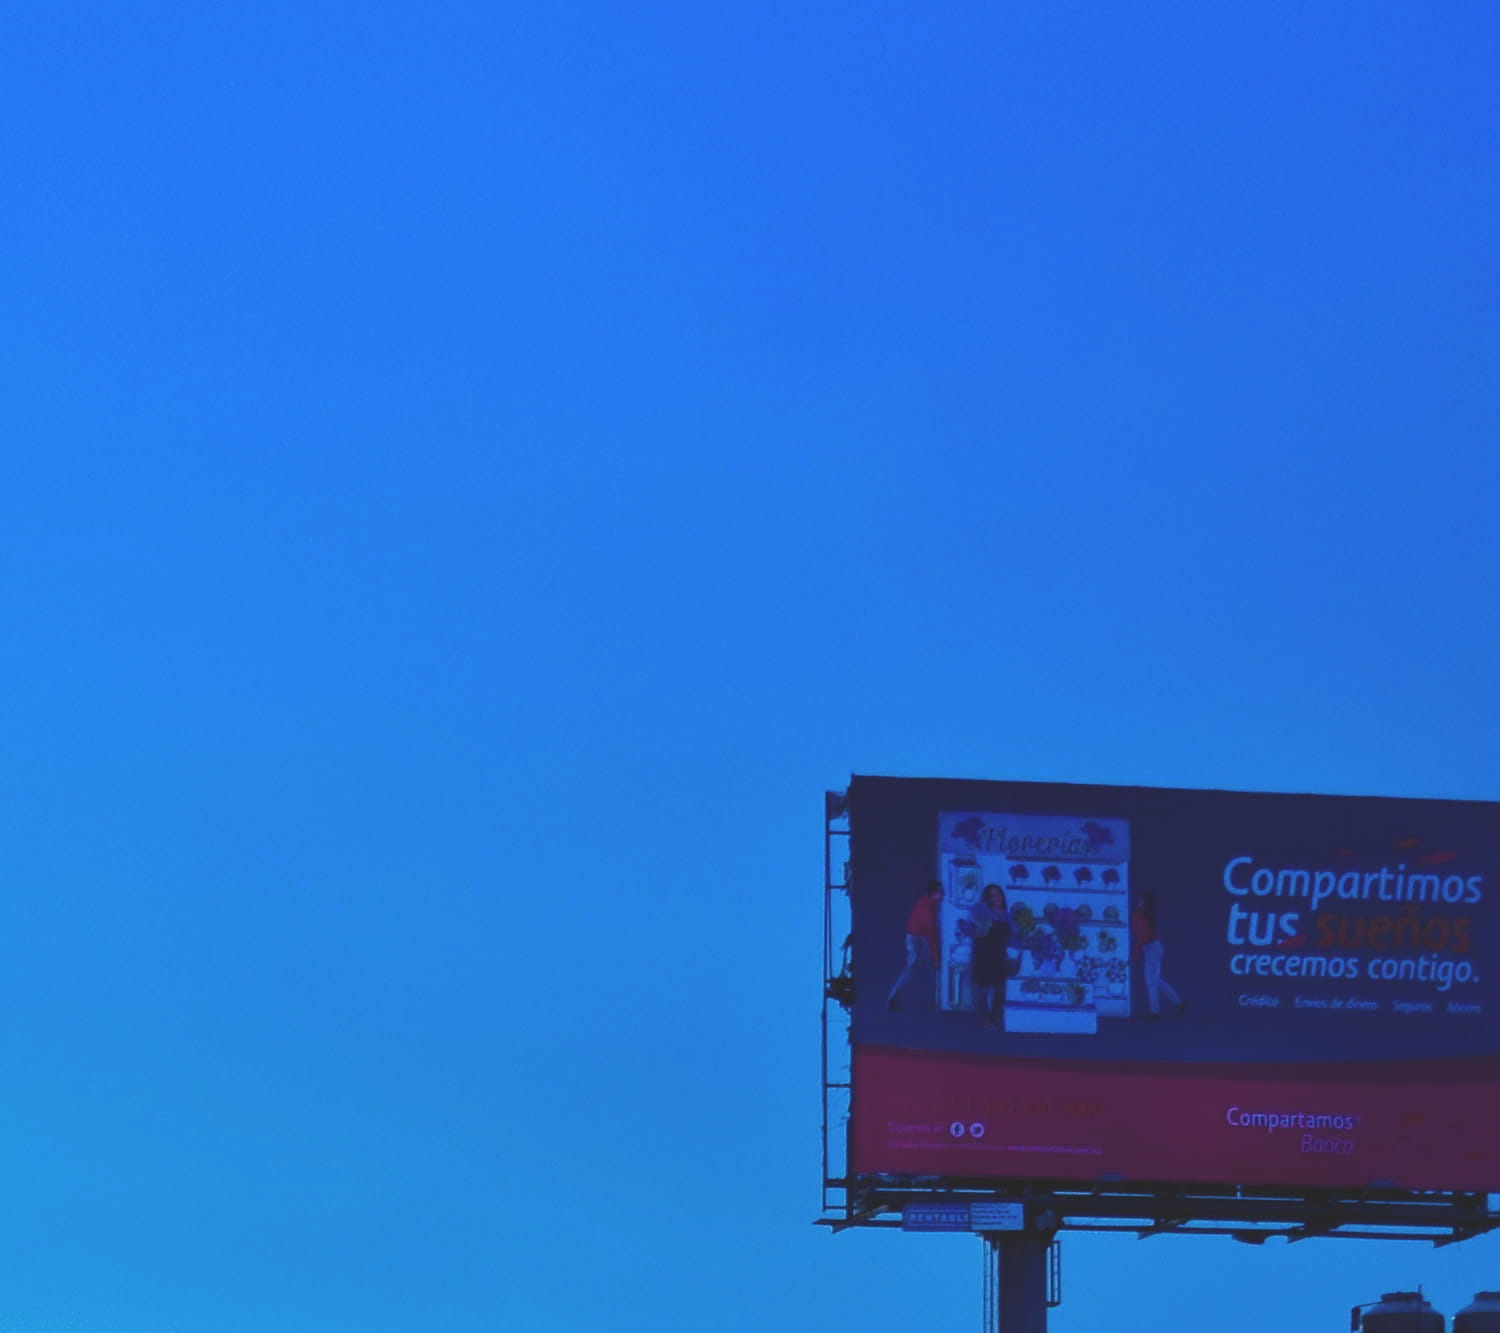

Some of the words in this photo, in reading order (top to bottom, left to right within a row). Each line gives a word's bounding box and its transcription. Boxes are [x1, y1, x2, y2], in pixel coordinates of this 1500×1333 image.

[1223, 856, 1482, 911] Compartimos
[1227, 903, 1299, 946] tus
[1315, 904, 1473, 951] sueños
[1230, 953, 1358, 979] crecemos
[1367, 953, 1480, 991] contigo.
[1226, 1106, 1353, 1135] Compartamos
[1301, 1133, 1355, 1154] Banco
